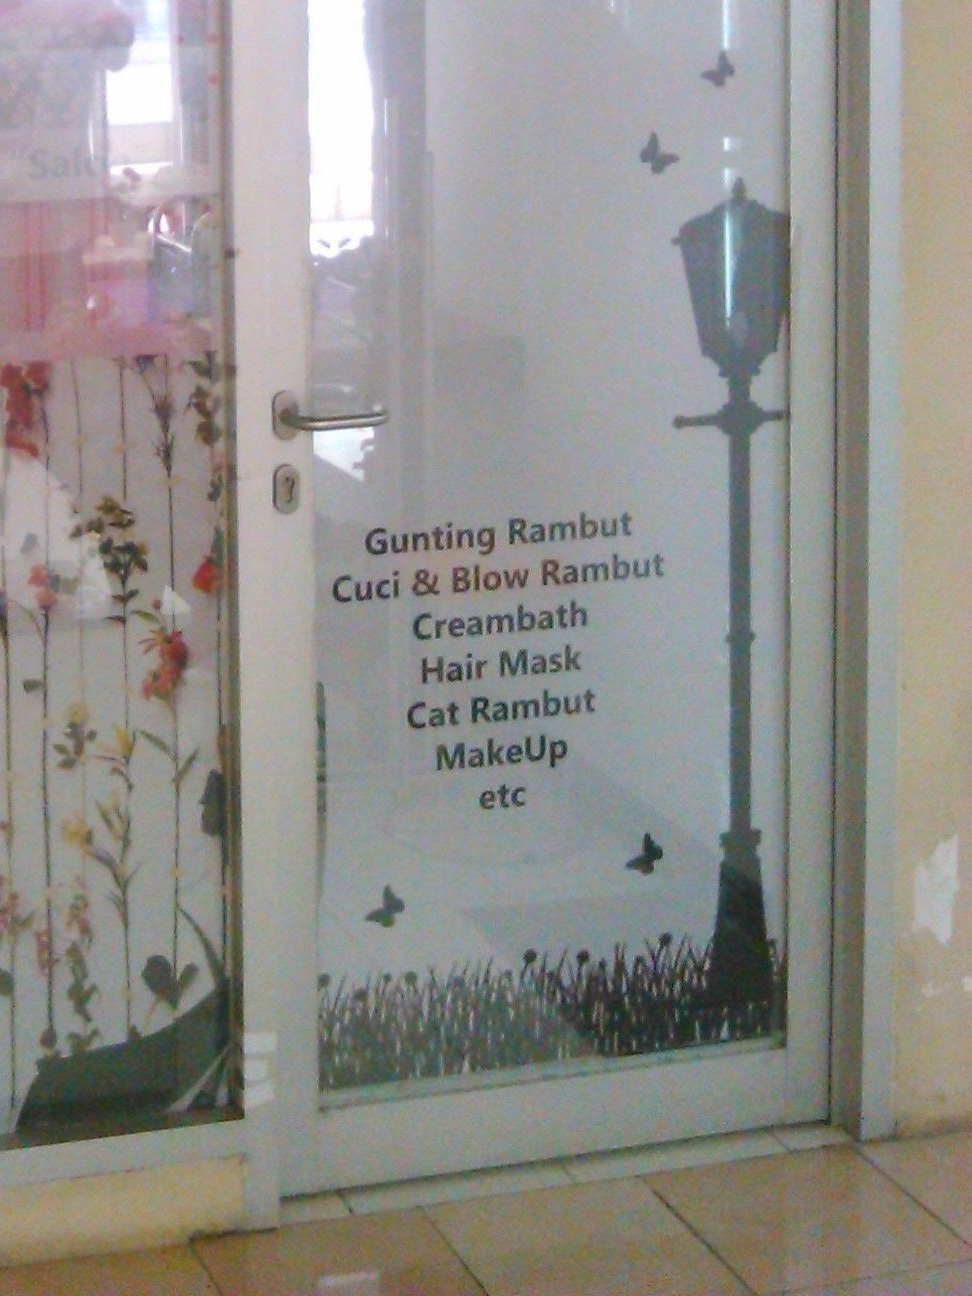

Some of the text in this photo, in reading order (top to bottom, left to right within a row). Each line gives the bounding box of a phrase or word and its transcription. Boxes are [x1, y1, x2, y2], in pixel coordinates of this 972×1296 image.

[364, 511, 633, 555] Gunting Rambut
[332, 553, 665, 604] Cuci & Blow Rambut
[412, 600, 588, 641] Creambath
[420, 644, 582, 684] Hair Mask
[406, 688, 596, 730] Cat Rambut
[436, 734, 569, 772] MakeUp
[479, 783, 527, 811] etc
